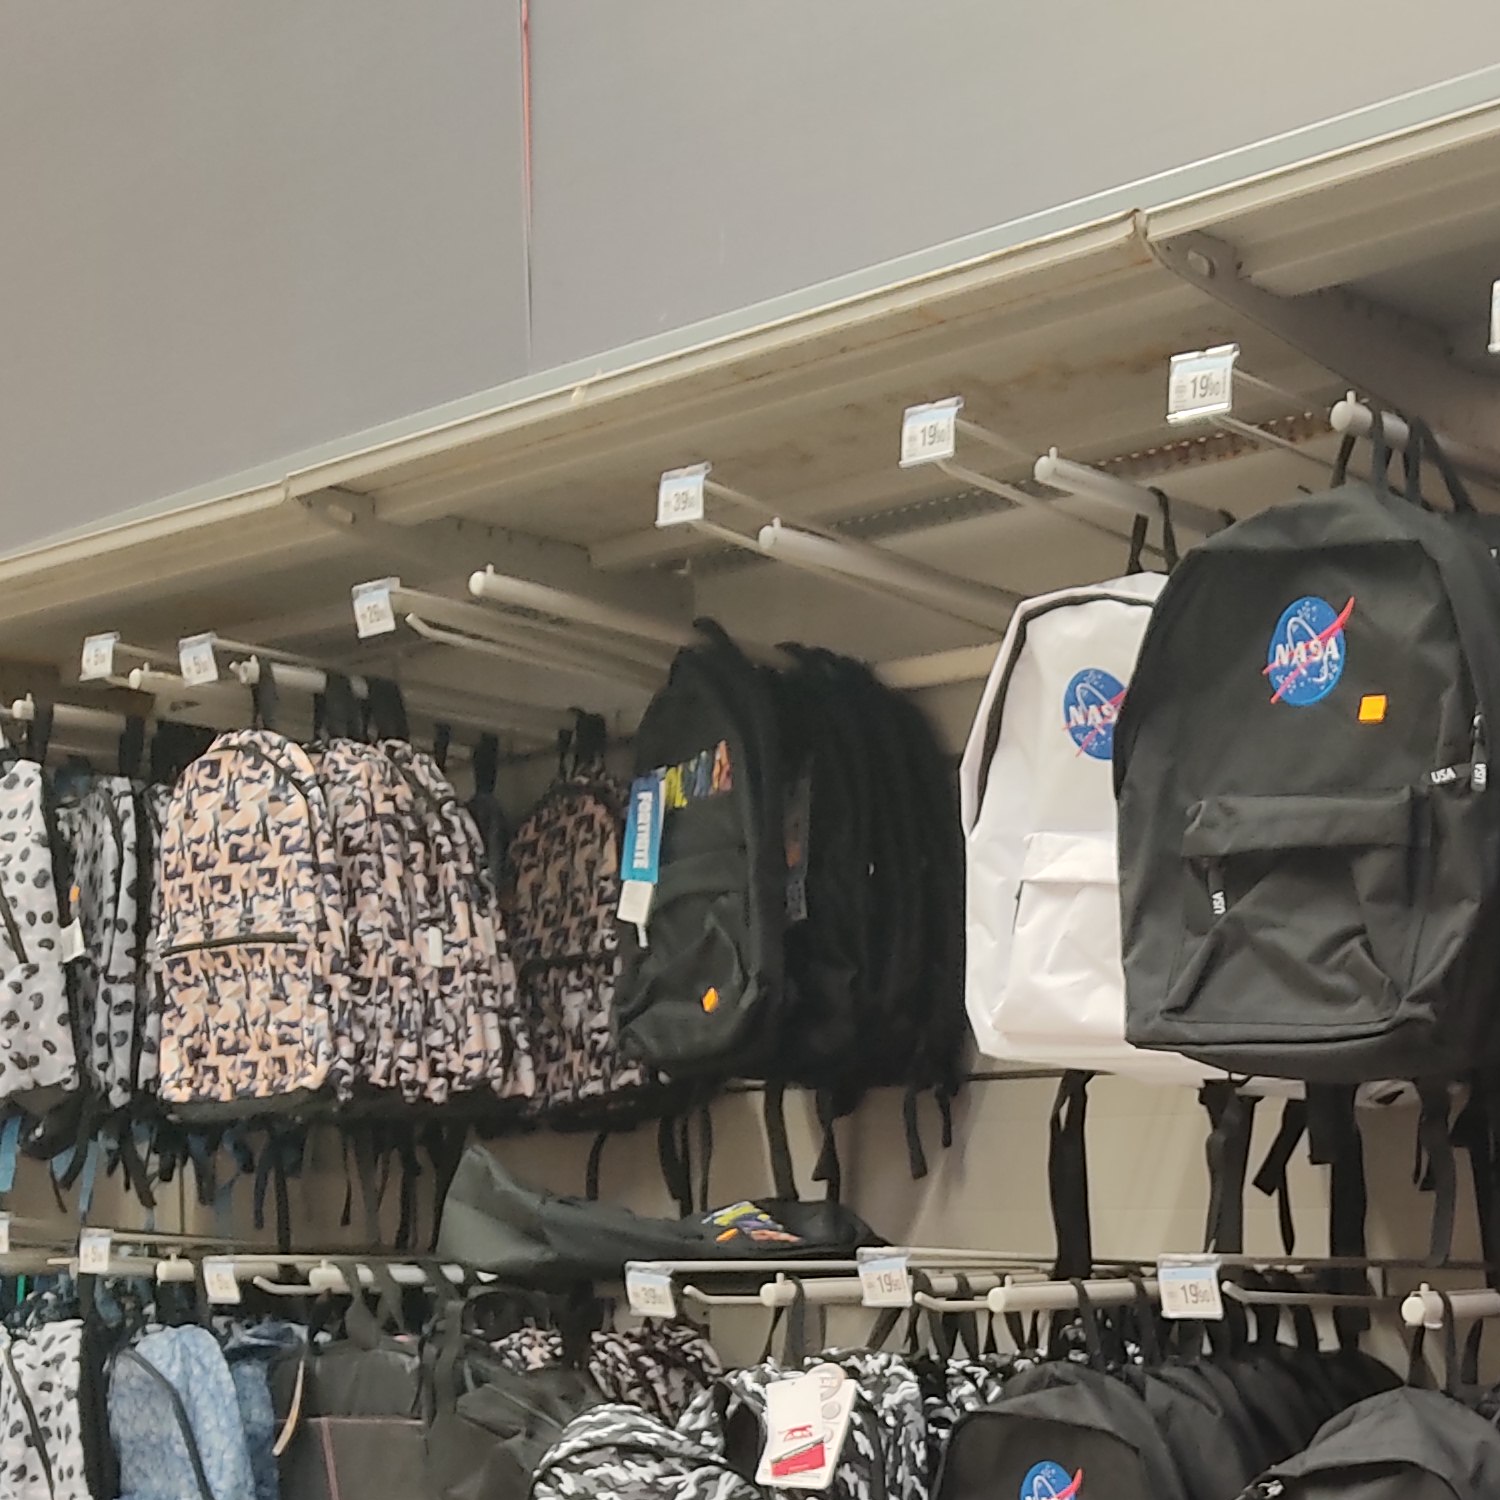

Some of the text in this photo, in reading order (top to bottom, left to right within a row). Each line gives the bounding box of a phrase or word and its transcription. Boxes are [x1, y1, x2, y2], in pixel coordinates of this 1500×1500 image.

[1274, 636, 1340, 668] NASA
[1069, 698, 1119, 727] NAS
[632, 791, 653, 869] FORTNITE
